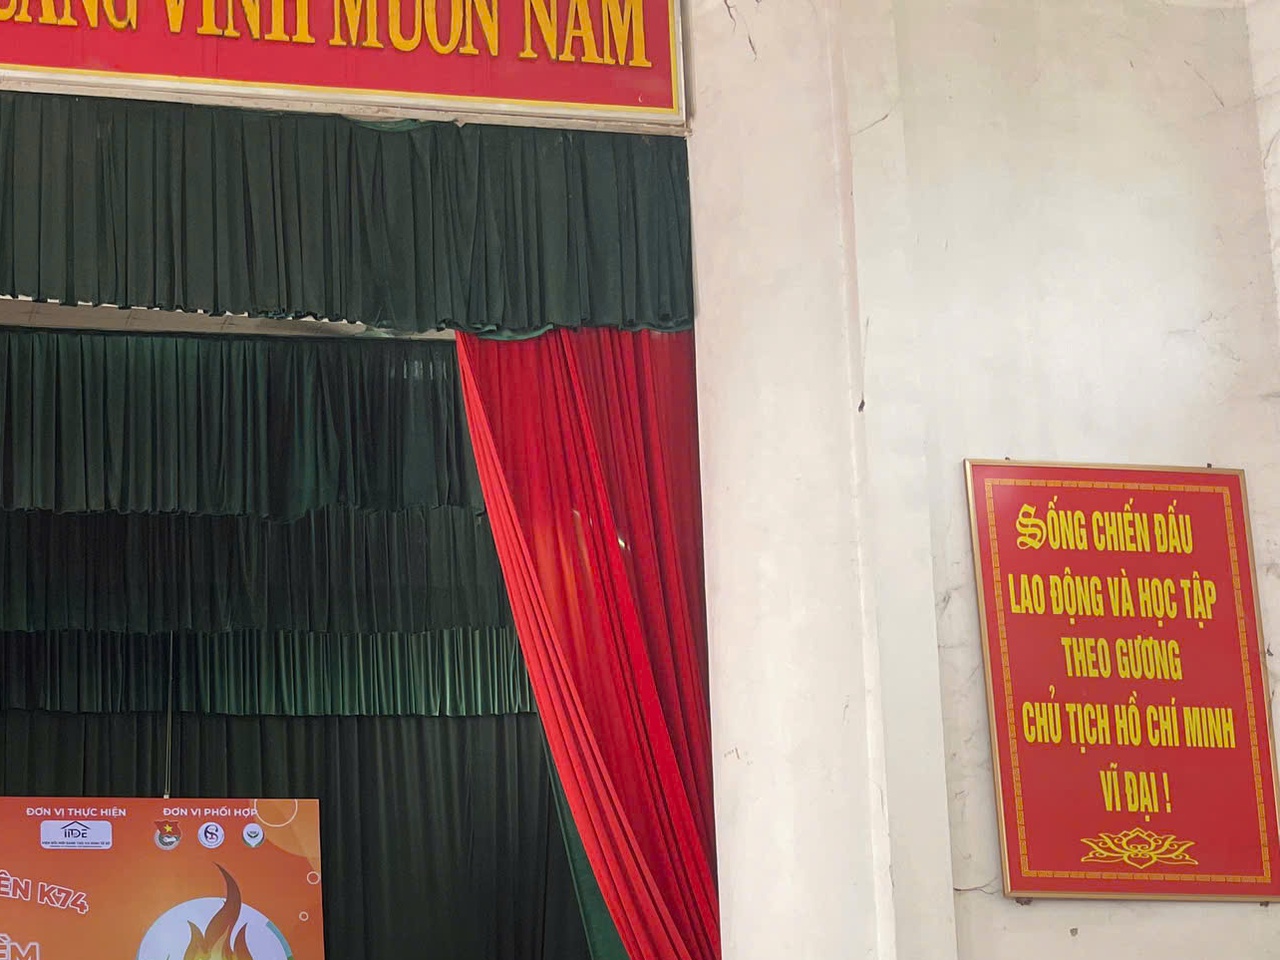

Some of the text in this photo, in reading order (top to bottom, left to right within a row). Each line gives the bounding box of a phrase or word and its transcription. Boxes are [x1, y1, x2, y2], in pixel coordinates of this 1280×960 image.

[1015, 496, 1193, 554] SỐNG CHIẾN ĐẤU
[1008, 567, 1217, 629] LAO ĐỘNG VÀ HỌC TẬP
[1060, 635, 1183, 680] THEO GƯƠNG
[1022, 685, 1236, 753] CHỦ TỊCH HỒ CHÍ MINH
[26, 806, 127, 818] ĐƠN VỊ THỰC HIỆN
[163, 805, 258, 818] ĐƠN VỊ PHỐI HỢP
[1099, 762, 1172, 822] VĨ ĐẠI !
[38, 882, 89, 915] K74
